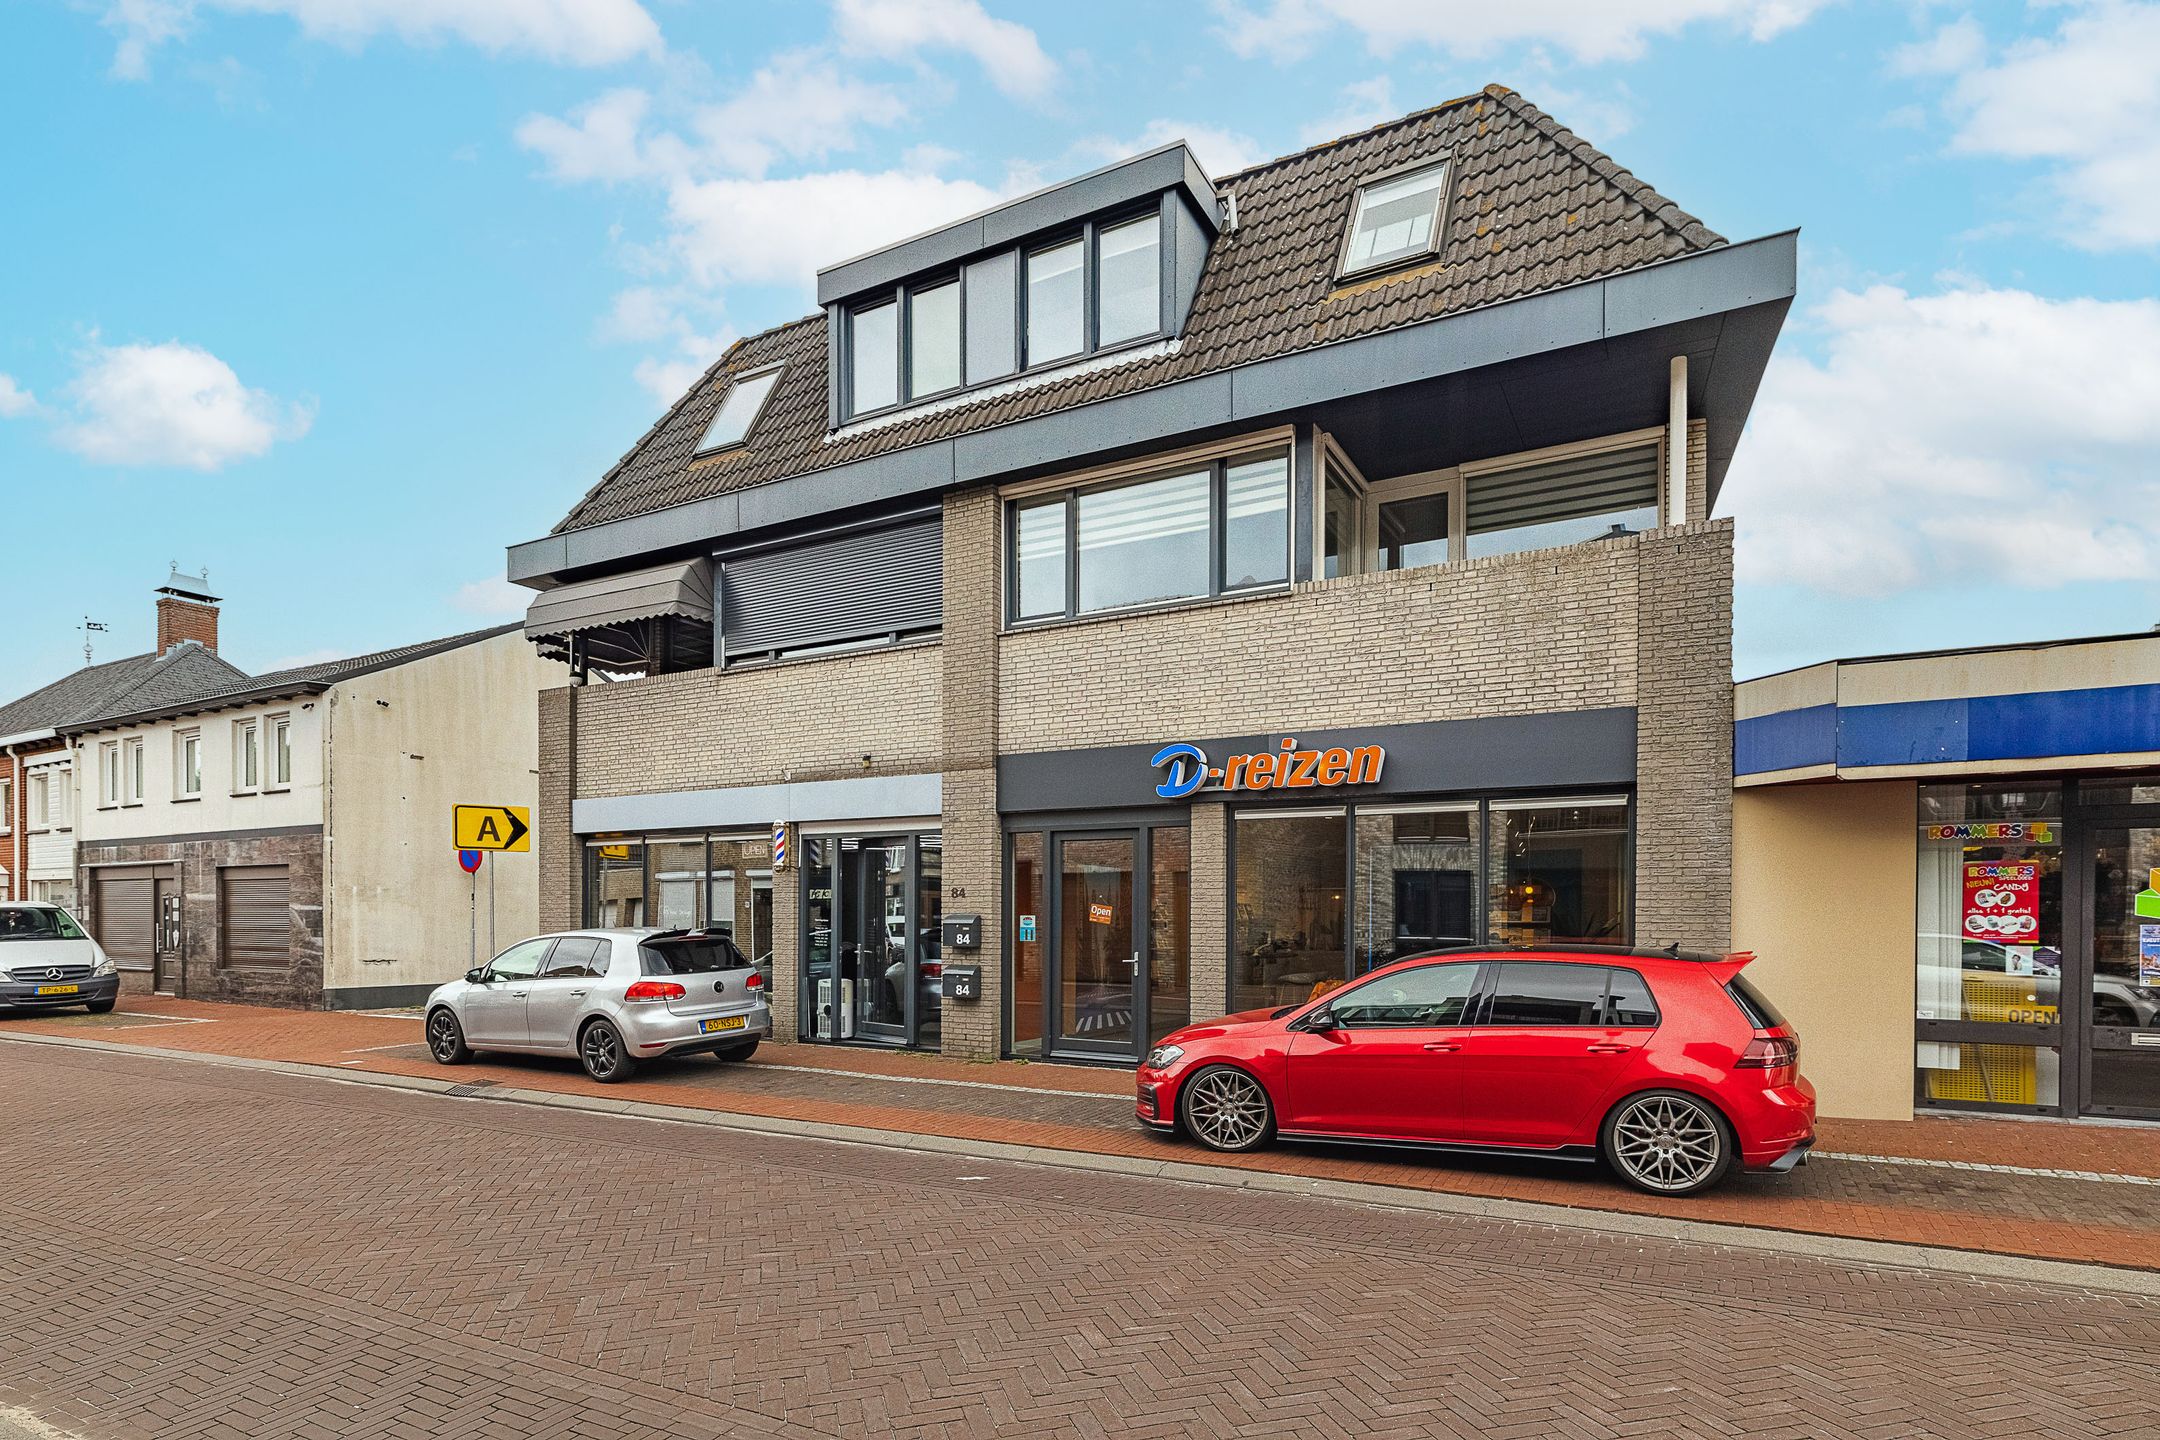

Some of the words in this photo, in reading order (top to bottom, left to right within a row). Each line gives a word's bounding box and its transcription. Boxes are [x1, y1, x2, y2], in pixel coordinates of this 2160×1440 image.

[1151, 738, 1386, 798] D-reizen
[476, 815, 502, 842] A
[1927, 823, 2023, 839] ROMMERS
[1968, 866, 2035, 877] ROMMERS
[1993, 882, 2029, 892] CANDY
[951, 888, 966, 899] 84
[1091, 905, 1112, 917] Open
[956, 933, 971, 945] 84
[955, 984, 970, 996] 84
[2008, 1009, 2057, 1024] OPEN
[708, 1017, 742, 1030] 60-NSJ-3
